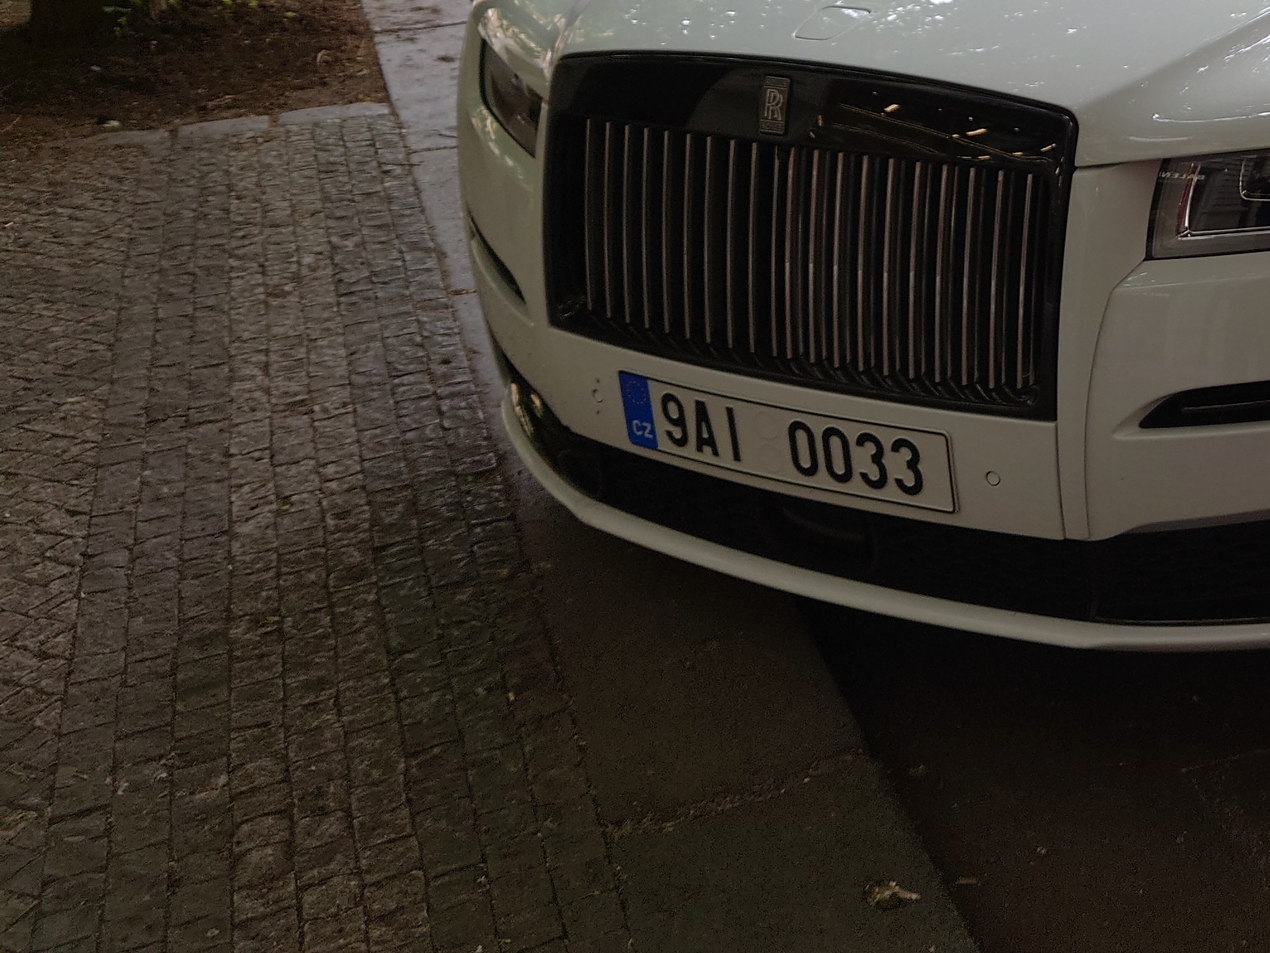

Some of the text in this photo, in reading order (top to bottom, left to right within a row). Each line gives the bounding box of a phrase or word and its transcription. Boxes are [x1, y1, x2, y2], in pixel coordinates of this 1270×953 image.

[631, 419, 654, 438] CZ
[660, 392, 923, 496] 9AI 0033
